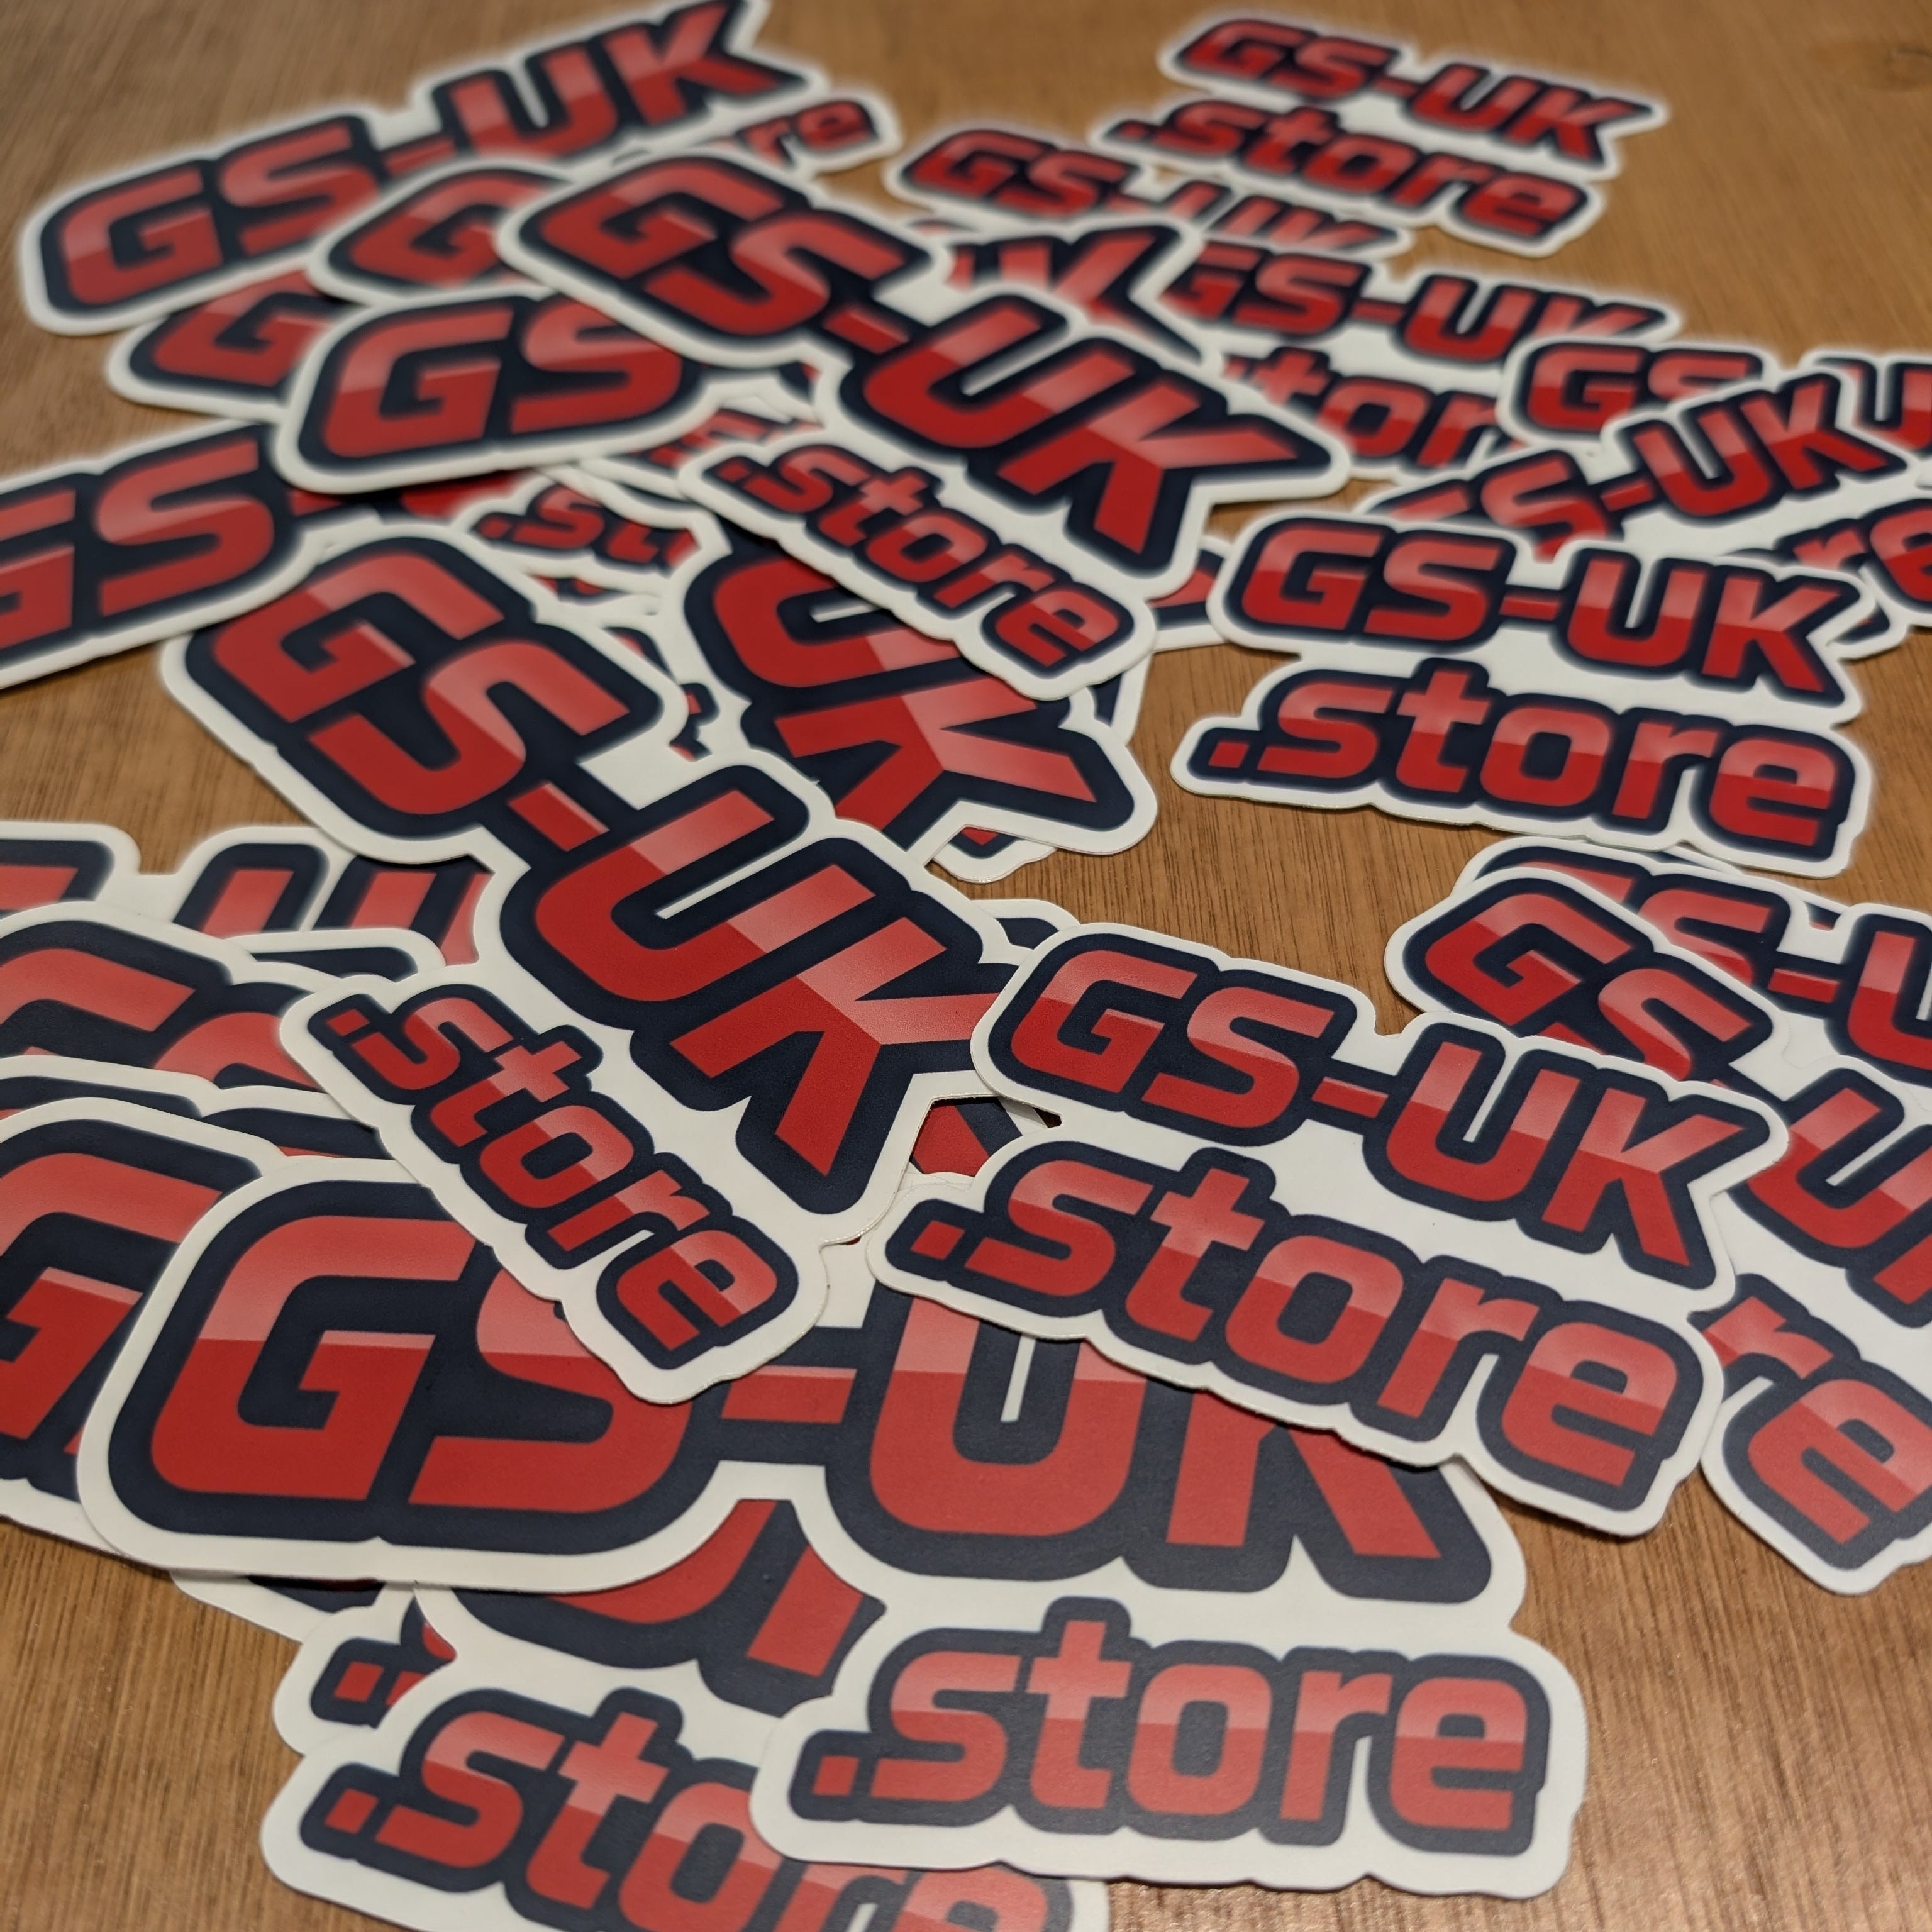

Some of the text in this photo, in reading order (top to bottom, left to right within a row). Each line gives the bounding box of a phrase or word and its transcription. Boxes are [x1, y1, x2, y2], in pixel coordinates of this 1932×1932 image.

[58, 1, 782, 308] GS-UK
[1112, 99, 1585, 239] .store
[1182, 19, 1653, 164] GS-UK
[536, 156, 1301, 556] GS-UK
[712, 445, 1123, 668] .store
[1387, 377, 1892, 560] S-UK
[1239, 523, 1846, 694] GS-UK
[210, 551, 1000, 1179] GS-UK
[1204, 668, 1838, 848] .store
[323, 995, 780, 1353] .store
[1008, 947, 1747, 1268] GS-UK
[908, 1157, 1679, 1489] .store
[809, 1619, 1528, 1833] .store
